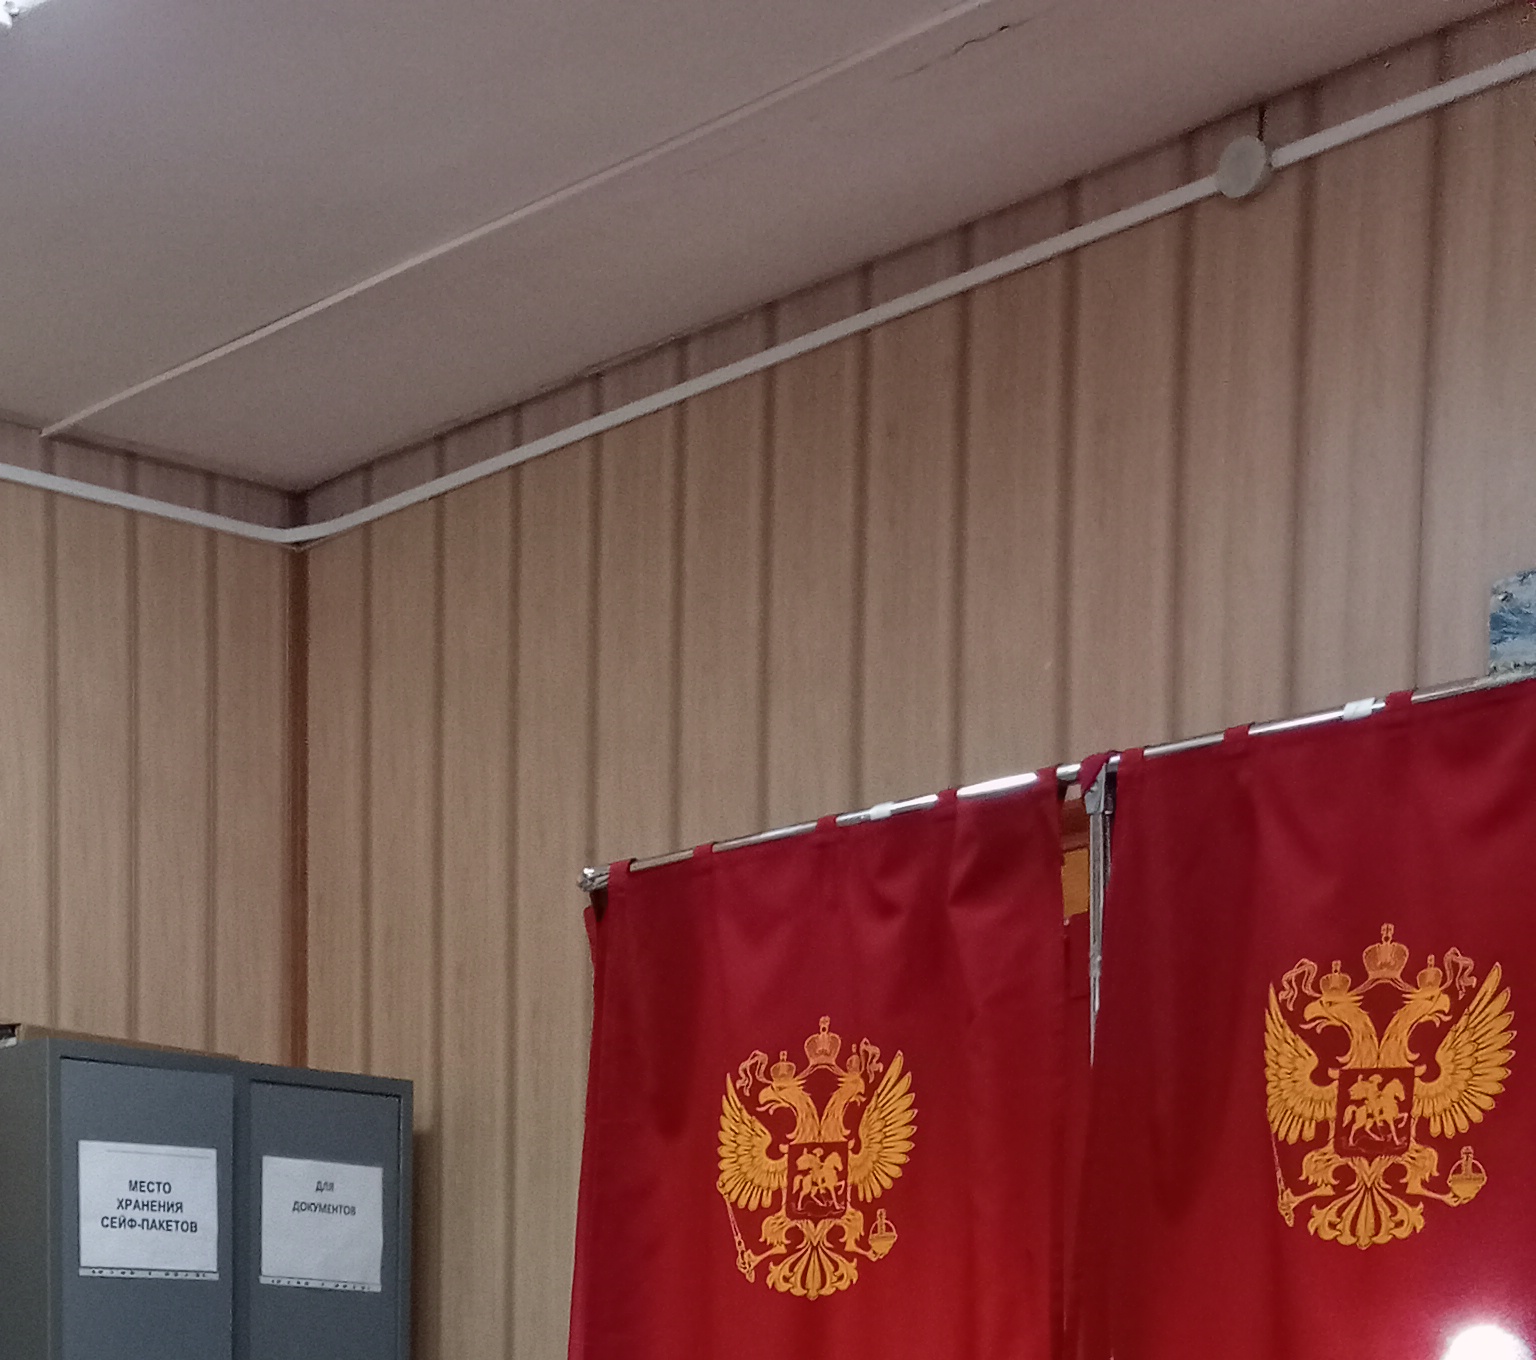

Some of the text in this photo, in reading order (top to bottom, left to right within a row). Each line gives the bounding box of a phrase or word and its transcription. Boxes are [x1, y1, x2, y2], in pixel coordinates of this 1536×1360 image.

[128, 1179, 172, 1195] МЕСТО
[314, 1180, 335, 1194] ДЛЯ
[116, 1197, 184, 1214] ХРАНЕНИЯ
[291, 1200, 357, 1217] ДОКУМЕНТОВ
[100, 1215, 198, 1234] СЕЙФ-ПАКЕТОВ
